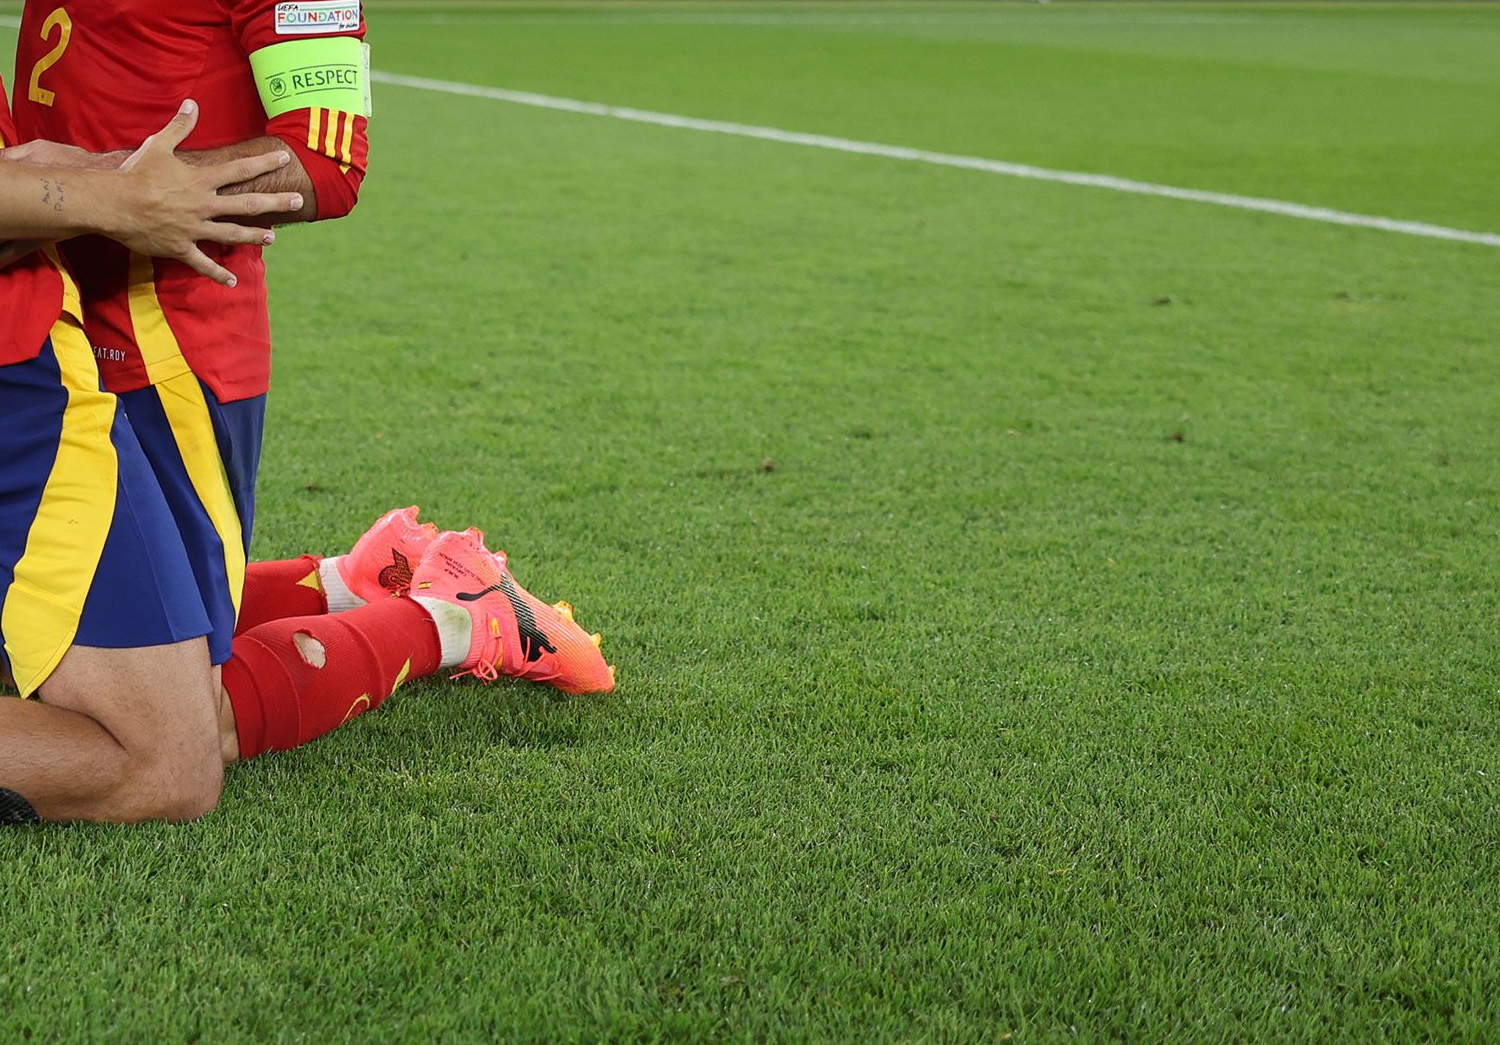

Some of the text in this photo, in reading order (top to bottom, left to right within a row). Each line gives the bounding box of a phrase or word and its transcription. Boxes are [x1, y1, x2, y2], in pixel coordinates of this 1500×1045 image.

[277, 4, 299, 12] UEFA
[278, 9, 358, 23] FOUNDATION
[27, 6, 73, 108] 2
[292, 69, 358, 90] RESPECT
